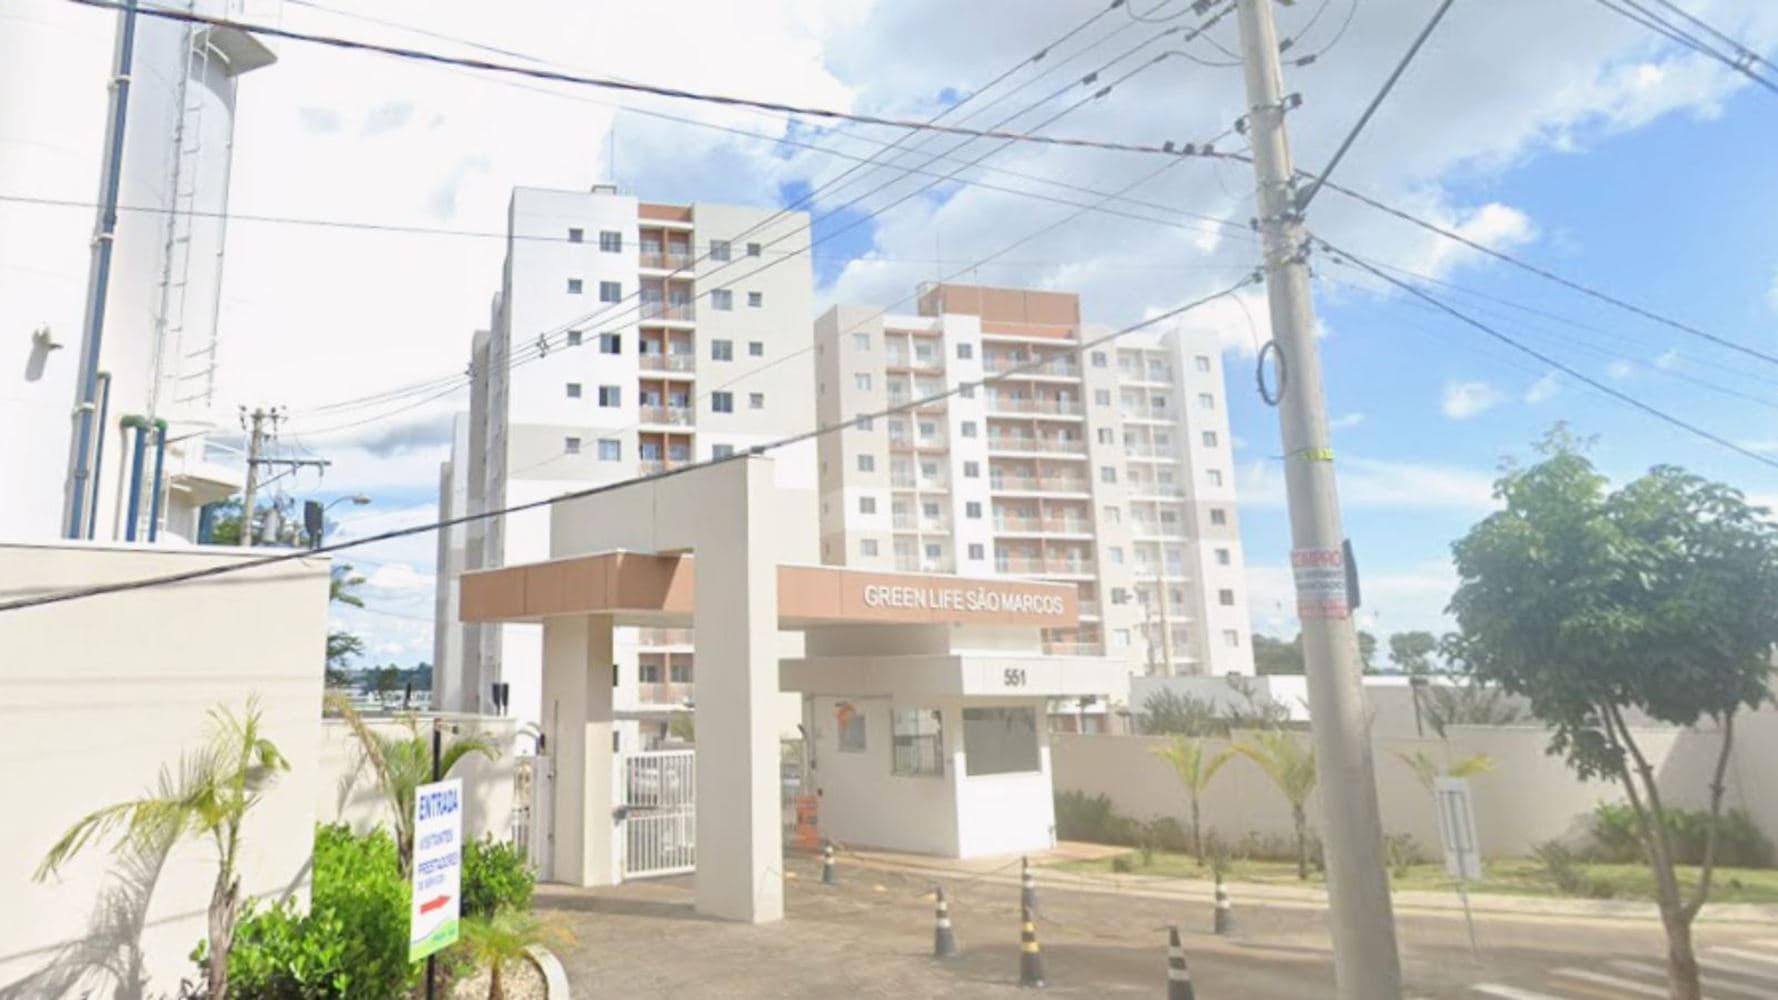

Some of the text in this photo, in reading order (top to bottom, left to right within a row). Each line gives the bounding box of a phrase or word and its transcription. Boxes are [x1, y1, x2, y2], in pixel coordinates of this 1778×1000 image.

[864, 585, 1064, 615] GREEN LIFE SÃO MARCOS
[1004, 668, 1026, 686] 551
[419, 789, 457, 820] ENTRADA
